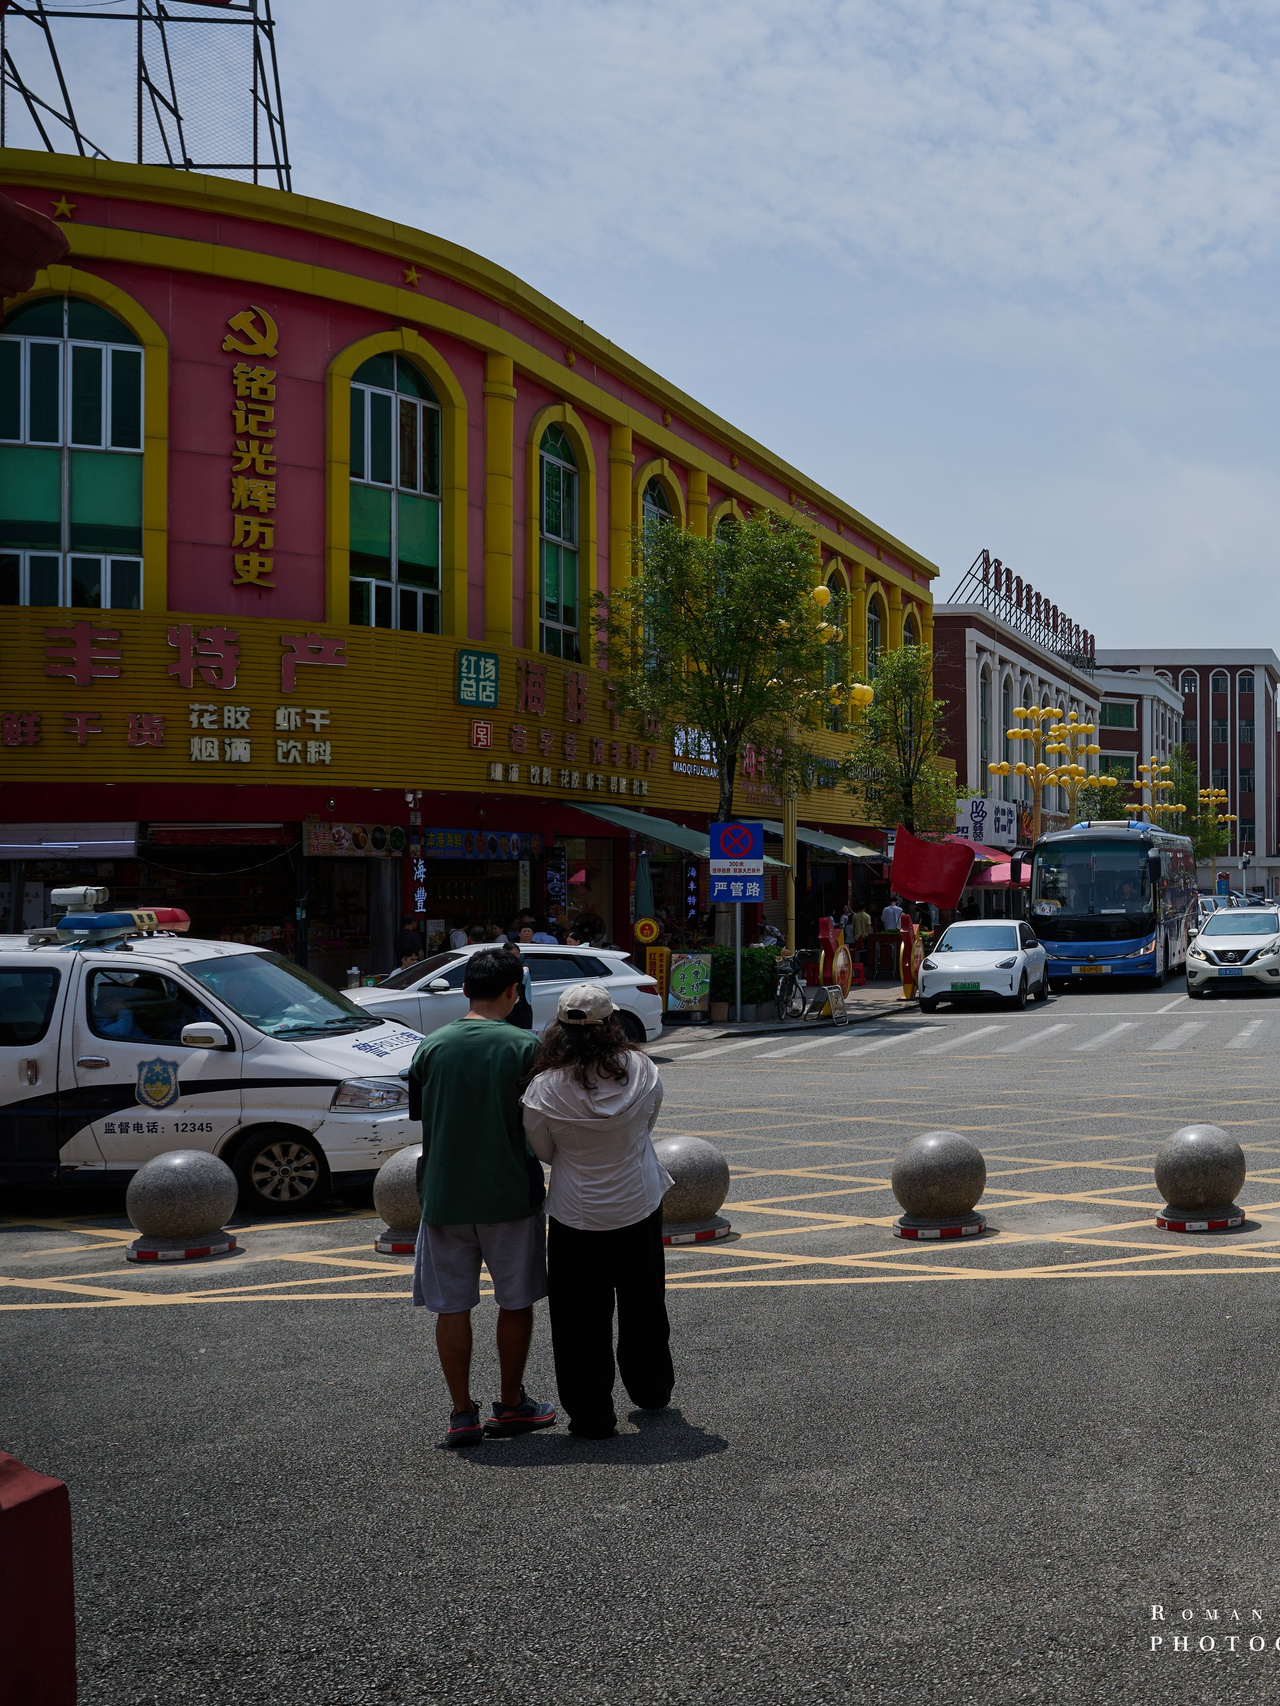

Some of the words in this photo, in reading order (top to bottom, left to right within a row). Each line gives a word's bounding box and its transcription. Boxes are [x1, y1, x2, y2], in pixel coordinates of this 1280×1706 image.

[231, 363, 277, 589] 铭记光辉历史
[44, 621, 348, 693] 丰特产
[461, 655, 496, 681] 红场
[460, 681, 496, 703] 总店
[0, 712, 167, 746] 鲜干货
[189, 704, 250, 730] 花胶
[275, 708, 331, 731] 虾干
[190, 737, 251, 762] 烟酒
[276, 739, 331, 764] 饮料
[413, 858, 428, 913] 海豐
[686, 866, 698, 919] 海丰特产
[713, 881, 761, 897] 严管路
[174, 1123, 213, 1133] 12345
